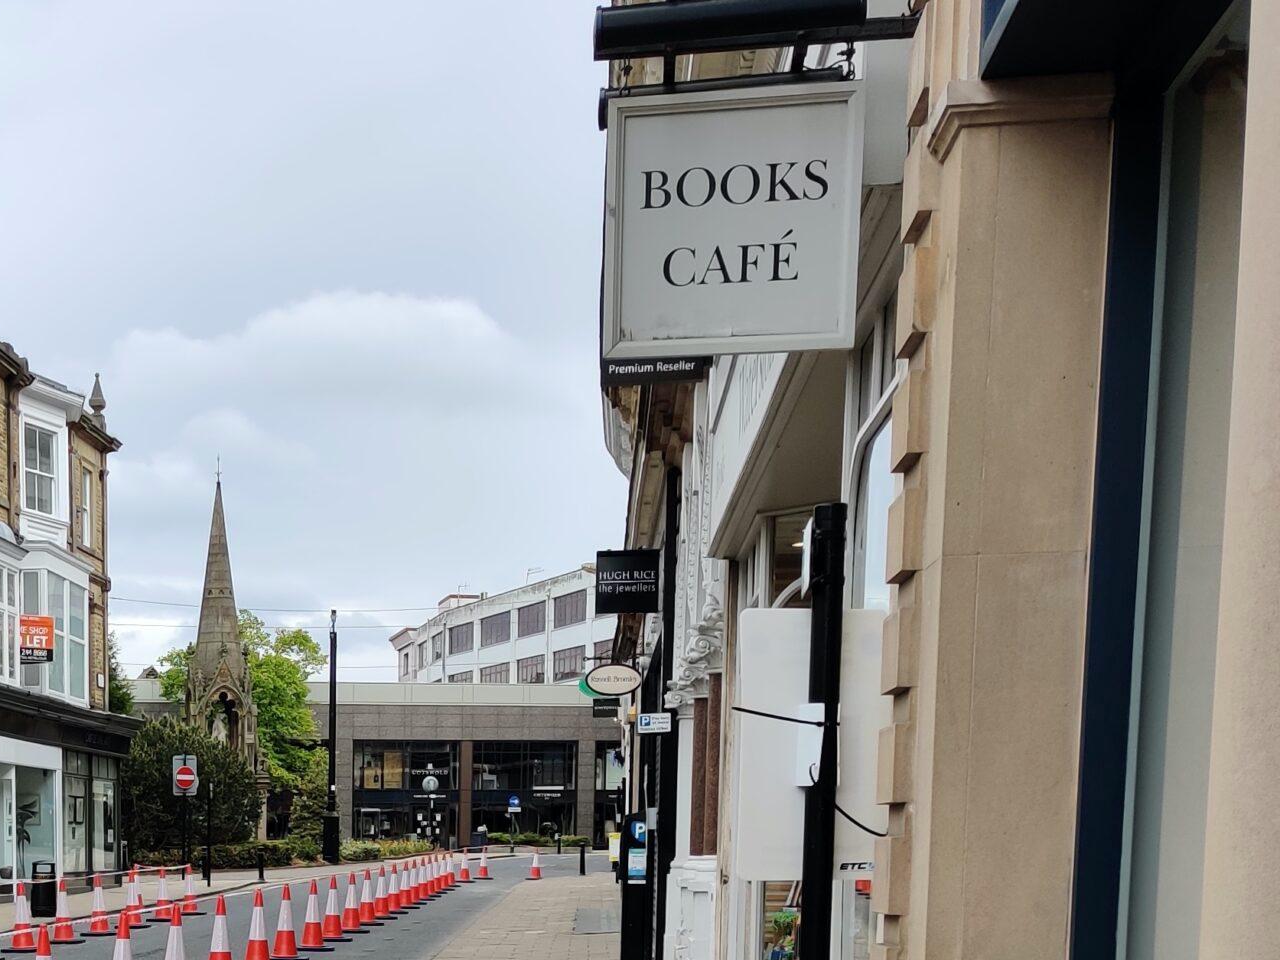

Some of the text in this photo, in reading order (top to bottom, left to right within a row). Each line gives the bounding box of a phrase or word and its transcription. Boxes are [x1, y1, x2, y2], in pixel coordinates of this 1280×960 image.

[640, 159, 829, 209] BOOKS
[663, 228, 799, 287] CAFÉ
[608, 360, 696, 374] Premium Reseller
[598, 570, 656, 580] HUGH RICE
[598, 582, 656, 594] the jewellers
[26, 635, 49, 648] LET
[840, 862, 868, 871] ETC
